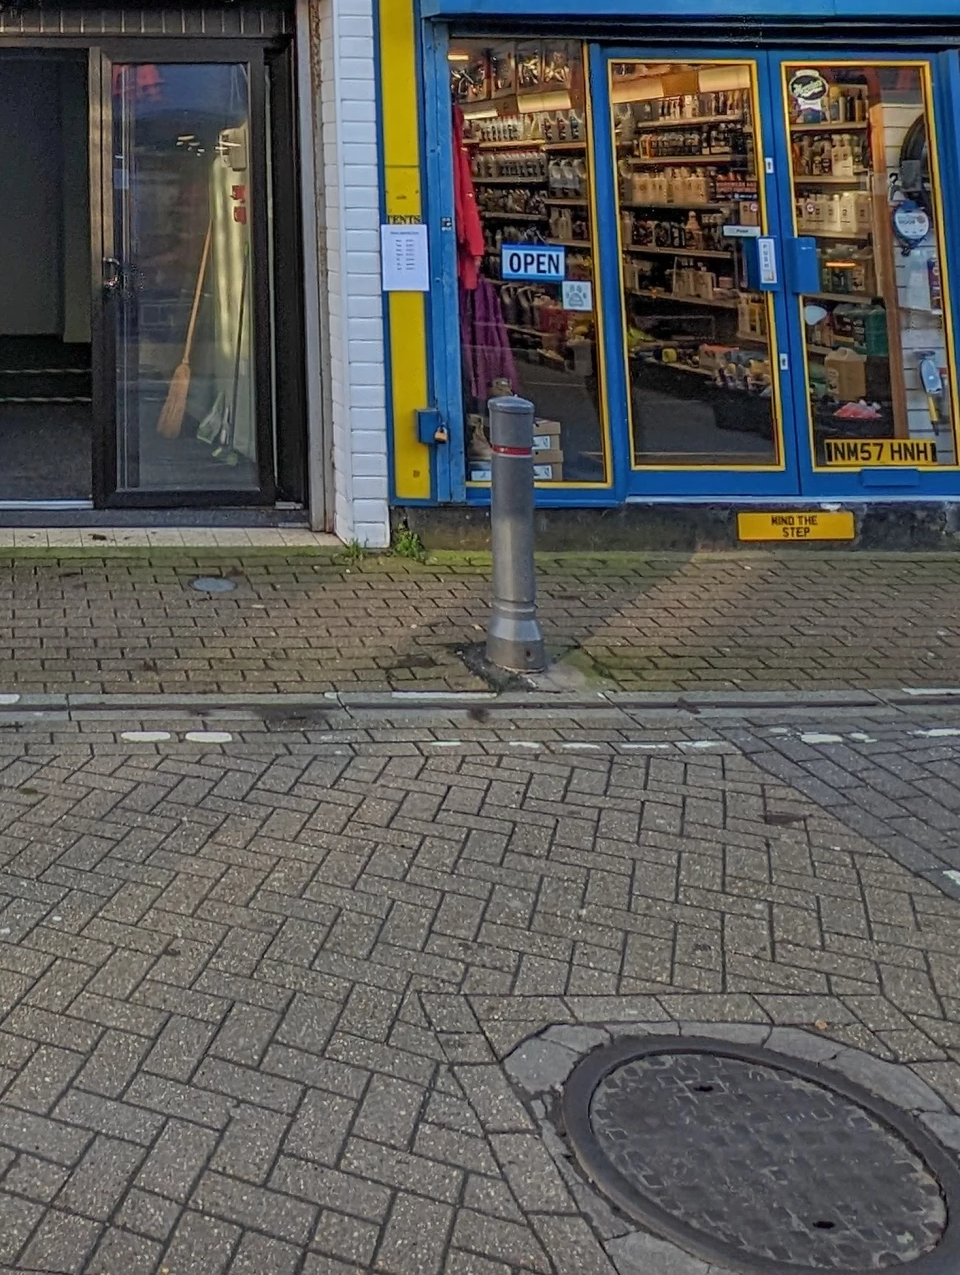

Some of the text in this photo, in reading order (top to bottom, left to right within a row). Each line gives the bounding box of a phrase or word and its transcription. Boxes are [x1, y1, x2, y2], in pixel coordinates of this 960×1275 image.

[509, 252, 560, 274] OPEN
[834, 442, 929, 462] NM57 HNH
[771, 515, 818, 526] MIND THE
[782, 527, 811, 537] STEP
